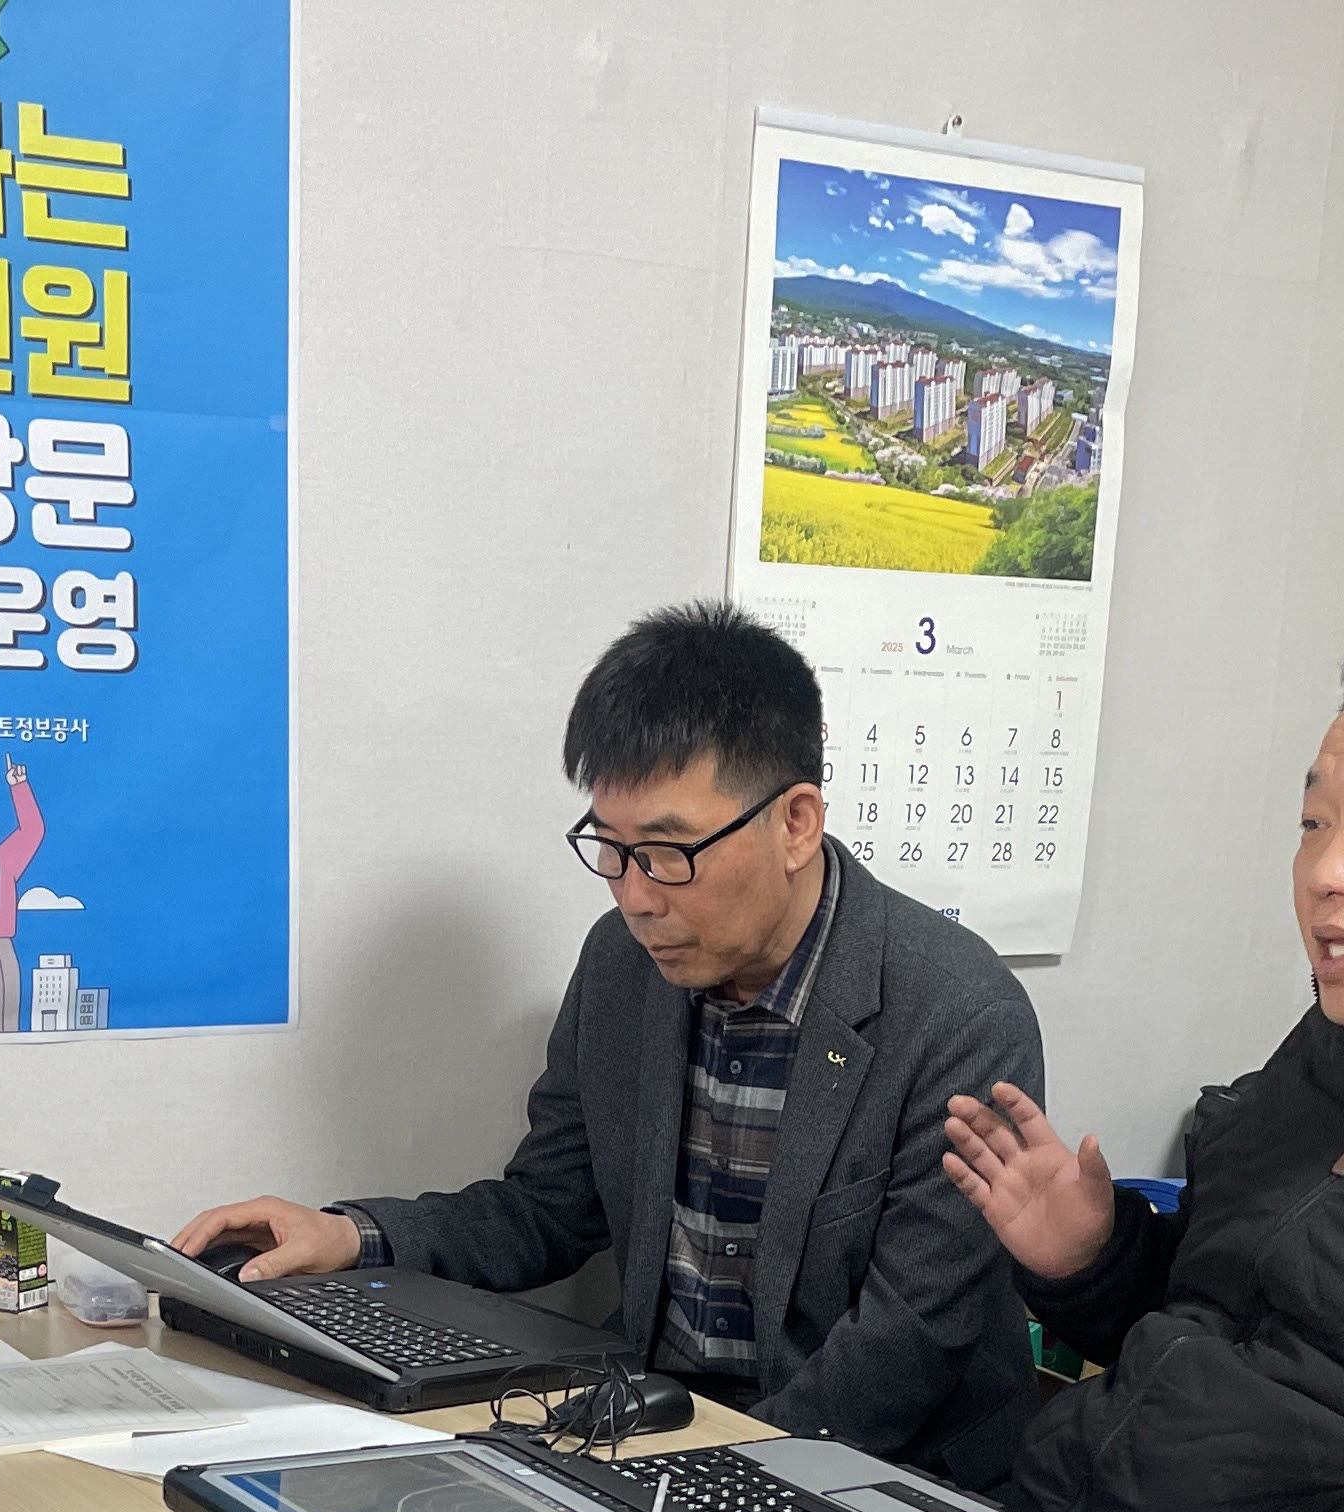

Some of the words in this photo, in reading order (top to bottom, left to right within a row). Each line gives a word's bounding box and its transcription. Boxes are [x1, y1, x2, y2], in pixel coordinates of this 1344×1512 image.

[881, 641, 904, 653] 2025
[915, 616, 936, 655] 3
[946, 644, 974, 656] March
[1056, 690, 1063, 711] 1
[866, 723, 878, 744] 4
[914, 725, 926, 746] 5
[961, 726, 973, 747] 6
[1008, 727, 1018, 748] 7
[1050, 728, 1061, 749] 8
[860, 763, 879, 784] 11
[908, 764, 929, 785] 12
[955, 765, 975, 786] 13
[1001, 766, 1019, 786] 14
[1044, 767, 1063, 787] 15
[857, 802, 878, 823] 18
[905, 803, 927, 823] 19
[950, 803, 973, 824] 20
[994, 804, 1014, 824] 21
[1037, 804, 1059, 824] 22
[852, 841, 874, 861] 25
[899, 841, 923, 862] 26
[946, 842, 969, 862] 27
[991, 842, 1013, 862] 28
[1034, 842, 1056, 862] 29
